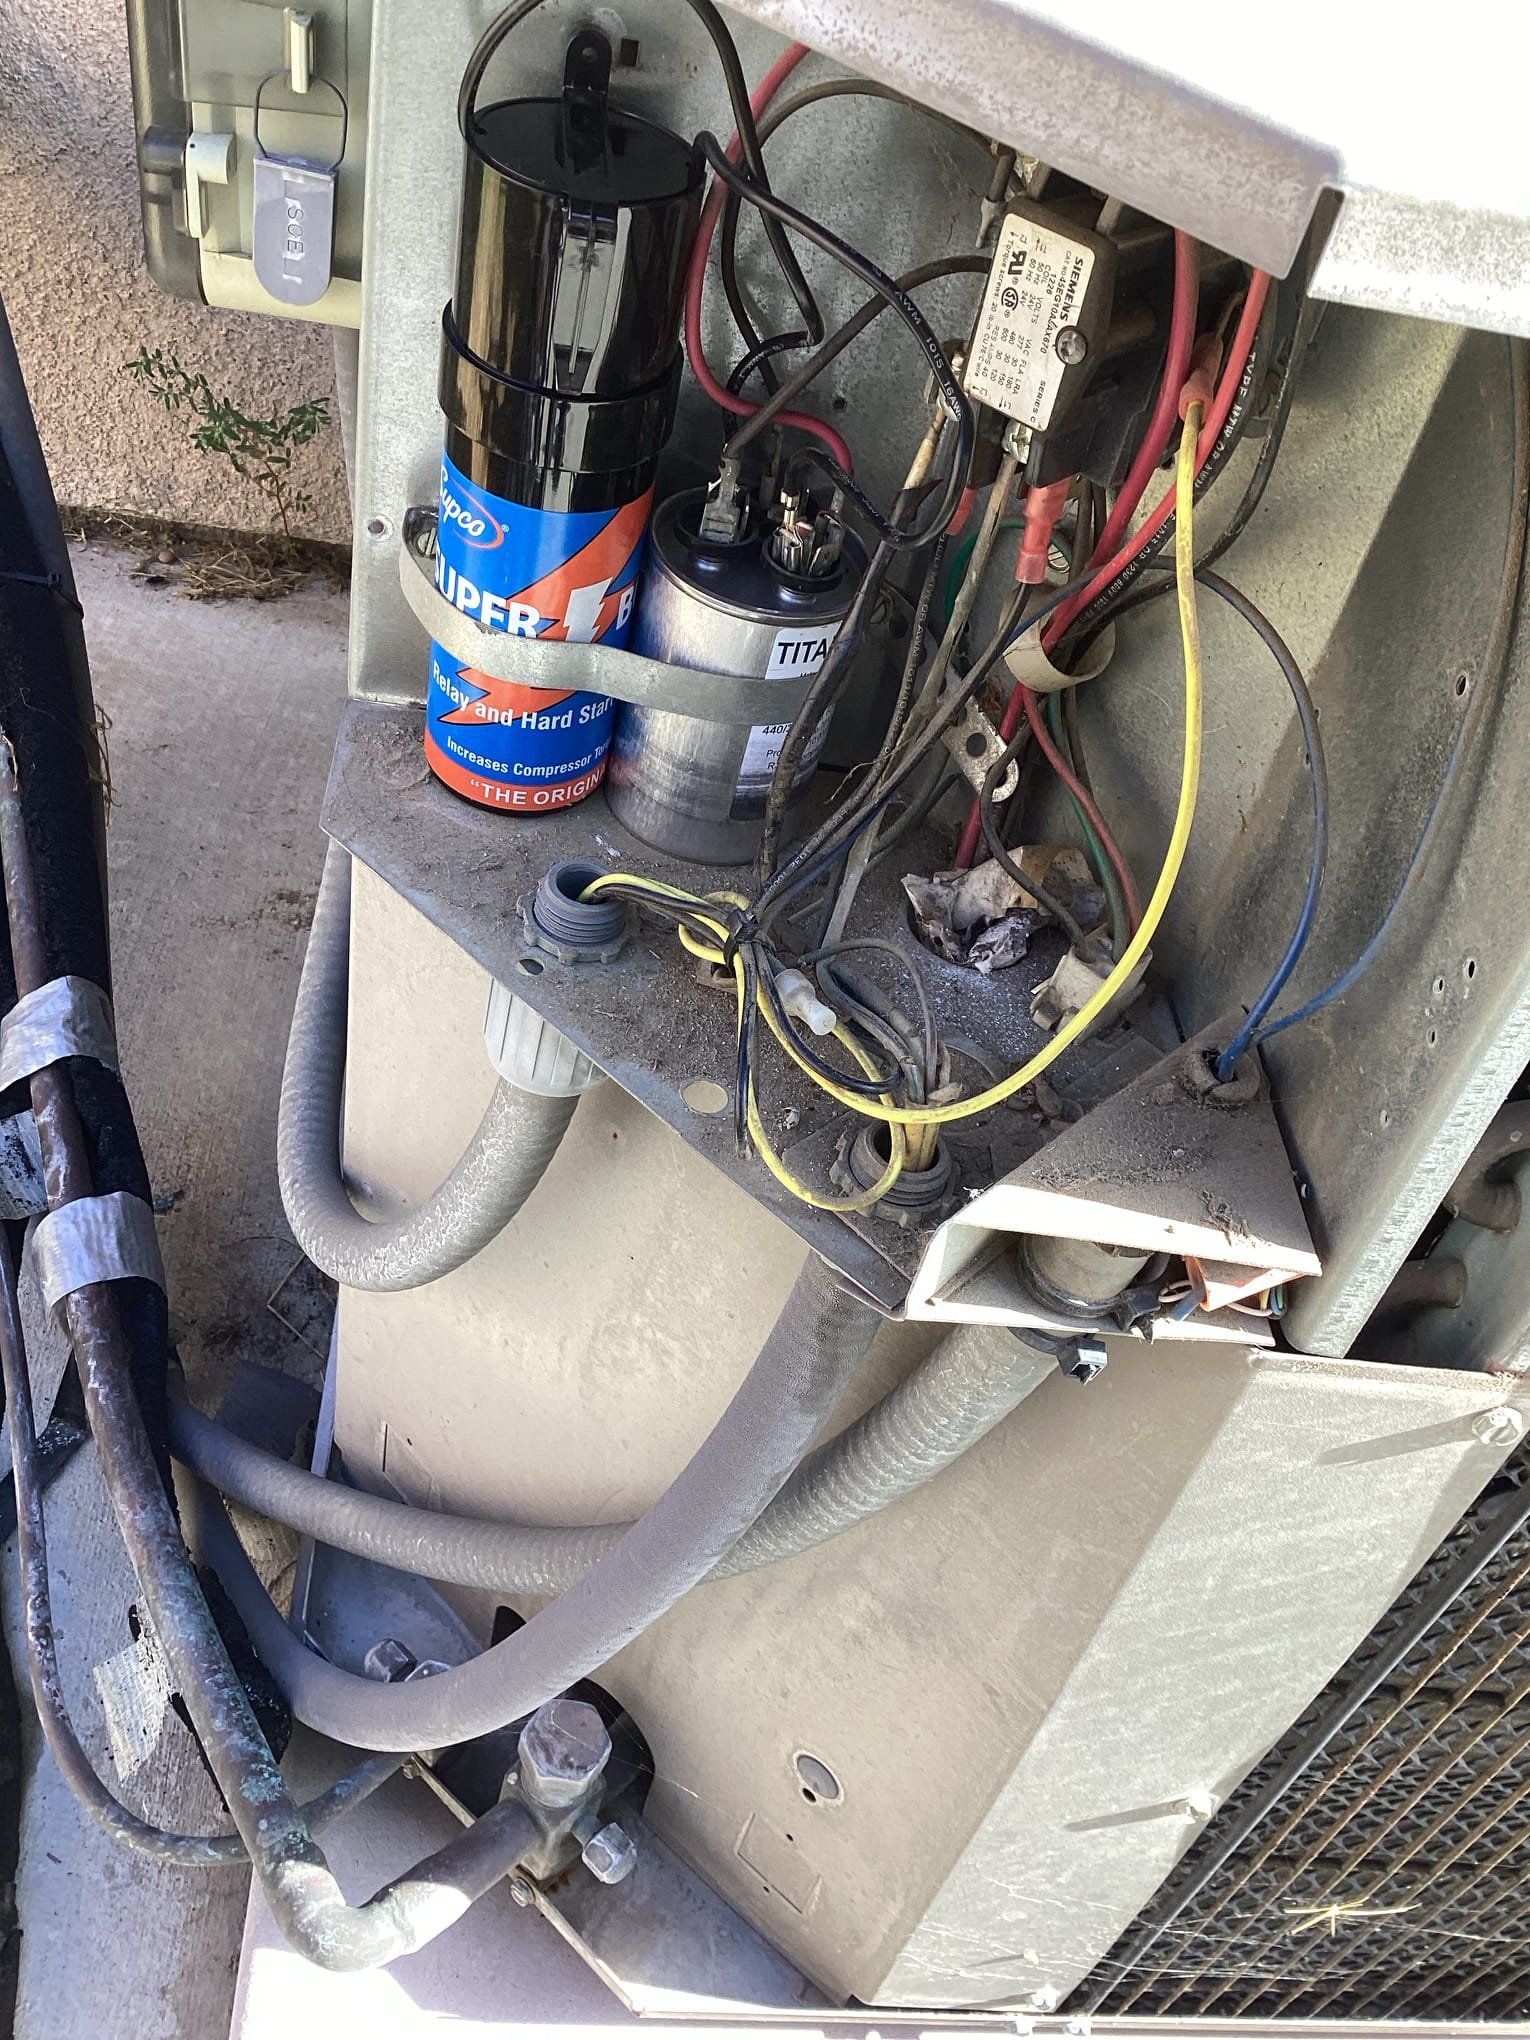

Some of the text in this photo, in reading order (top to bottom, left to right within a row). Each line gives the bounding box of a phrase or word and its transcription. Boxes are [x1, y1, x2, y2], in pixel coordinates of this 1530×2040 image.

[287, 205, 304, 253] SCE
[999, 238, 1014, 268] Torque
[1062, 249, 1071, 265] CAT
[1018, 289, 1028, 307] 24V
[1025, 261, 1044, 311] 50 Hz 24V
[1029, 263, 1051, 324] COIL VOLTS
[1045, 272, 1057, 295] 1226
[1059, 255, 1084, 322] SIEMENS
[895, 290, 922, 325] AWM
[925, 336, 945, 369] 1015
[989, 367, 998, 382] 120
[994, 349, 1003, 360] 30
[996, 329, 1017, 386] 480 30 150
[1004, 334, 1024, 389] 277 30 180
[1011, 337, 1032, 395] VAC FLA LRA
[1238, 351, 1256, 397] TYPE
[1029, 379, 1046, 423] SERIES C
[1222, 403, 1244, 439] MTW
[440, 464, 486, 537] Supco
[777, 637, 827, 665] TITA
[433, 659, 470, 713] Relay
[475, 702, 512, 727] and
[521, 710, 573, 731] Hard
[447, 735, 509, 774] Increases
[513, 756, 593, 779] Compressor
